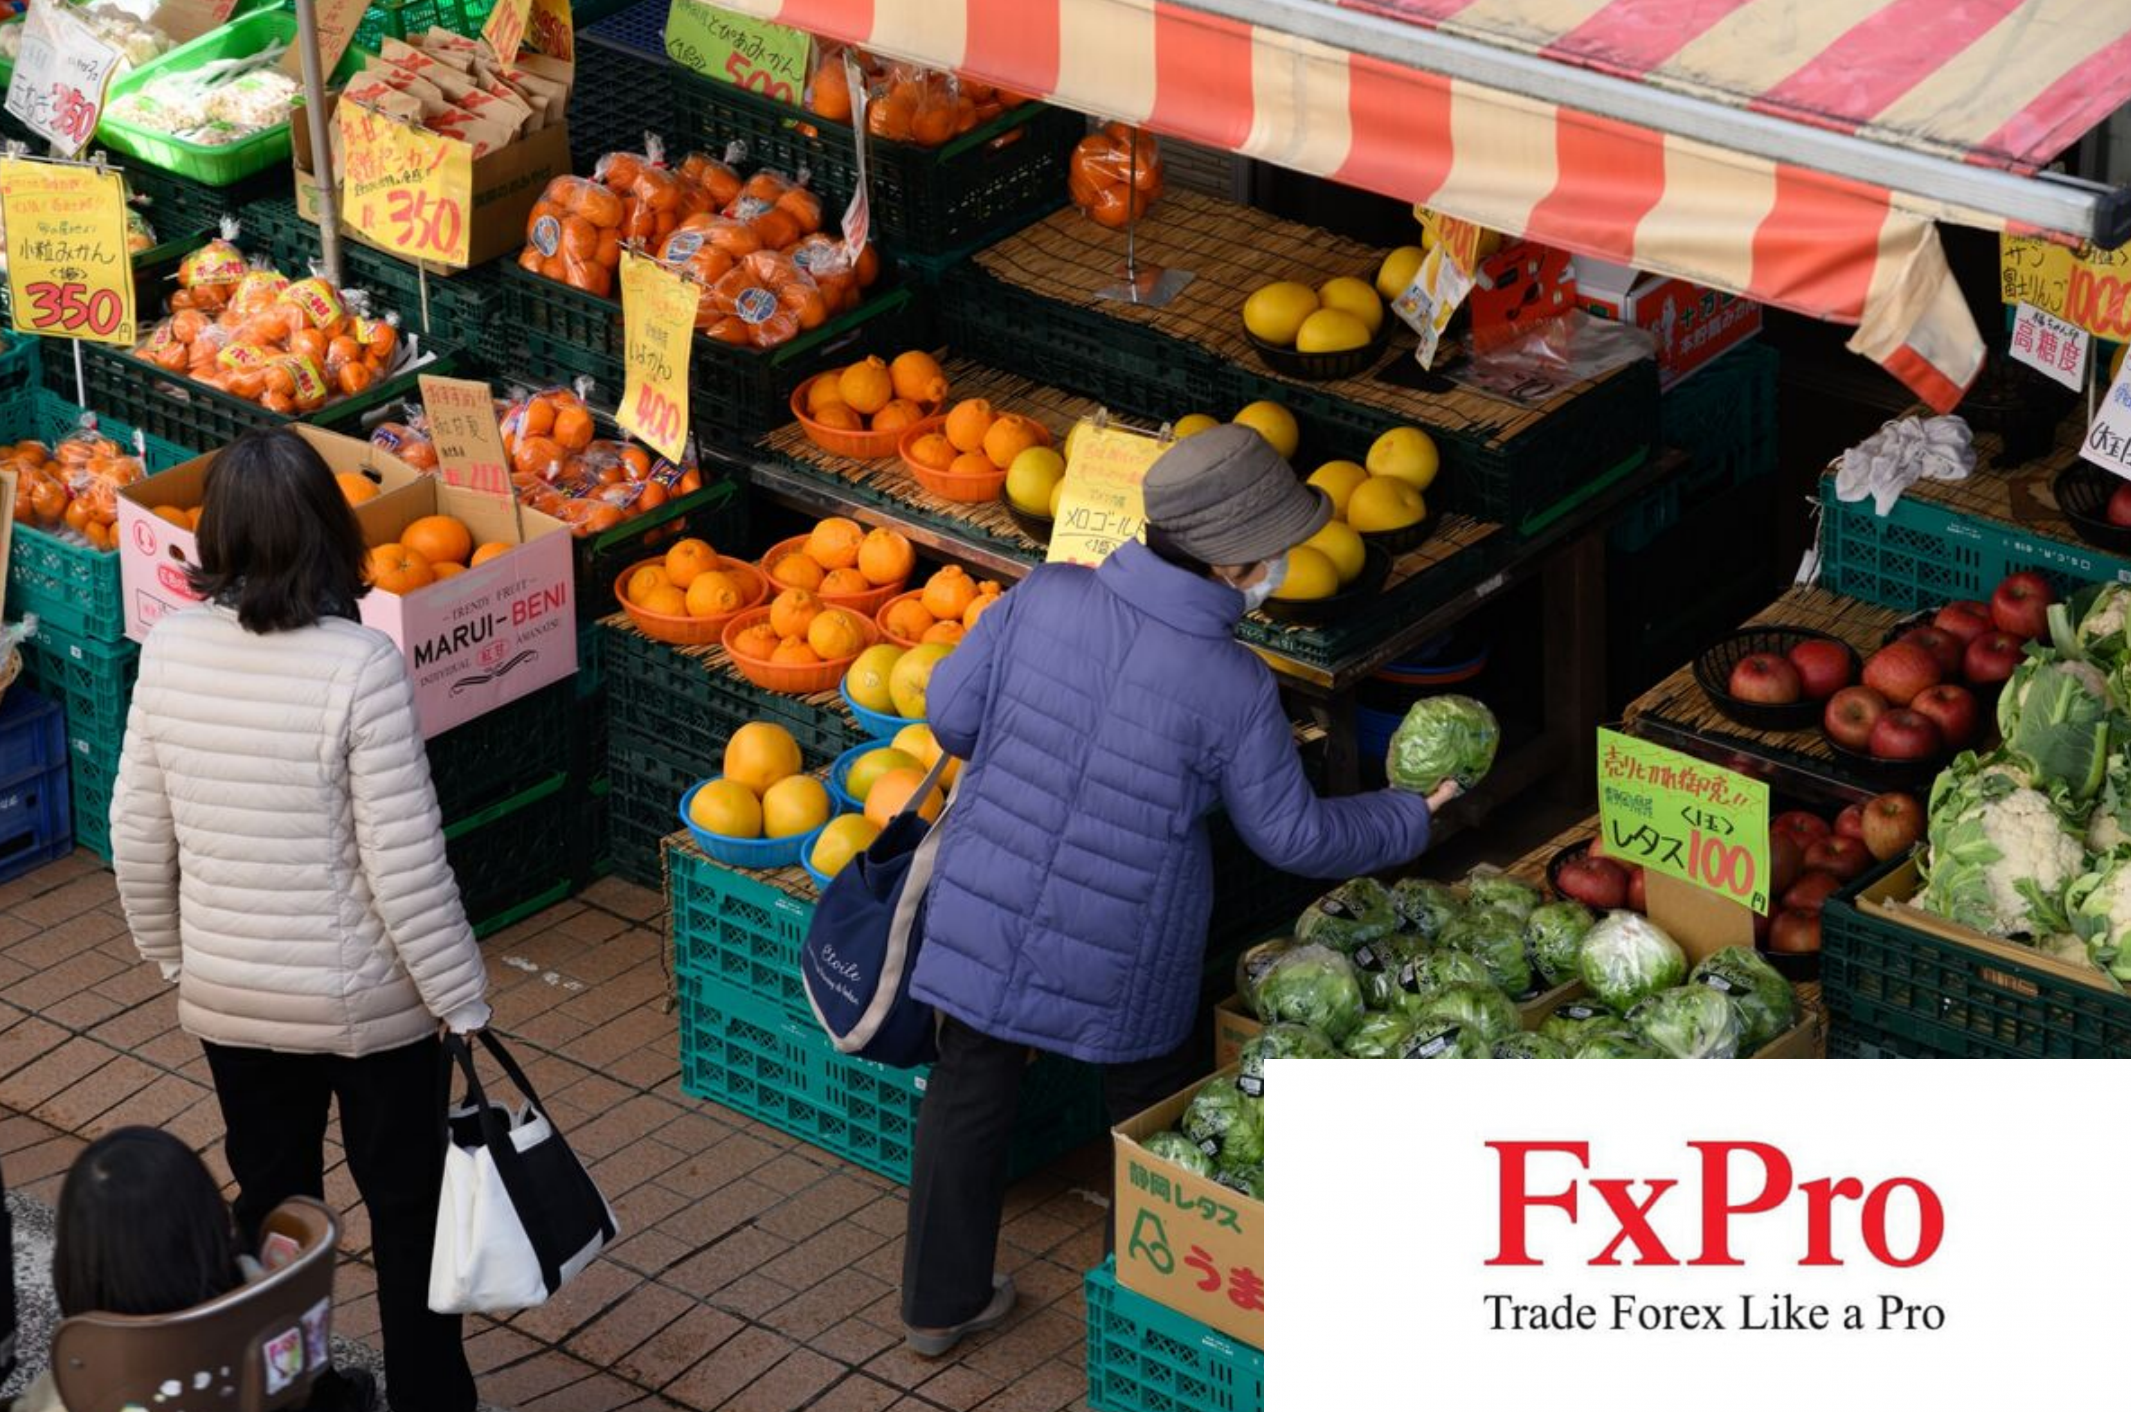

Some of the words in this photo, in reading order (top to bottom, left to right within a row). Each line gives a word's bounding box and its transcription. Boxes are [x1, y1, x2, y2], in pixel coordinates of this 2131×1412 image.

[725, 51, 793, 105] 500
[387, 189, 461, 253] 350
[19, 238, 116, 264] 小粒みかん
[25, 282, 122, 336] 350
[2014, 317, 2081, 376] 高糖度
[636, 382, 681, 446] 400
[1612, 819, 1685, 869] レタス
[1688, 829, 1755, 896] 100
